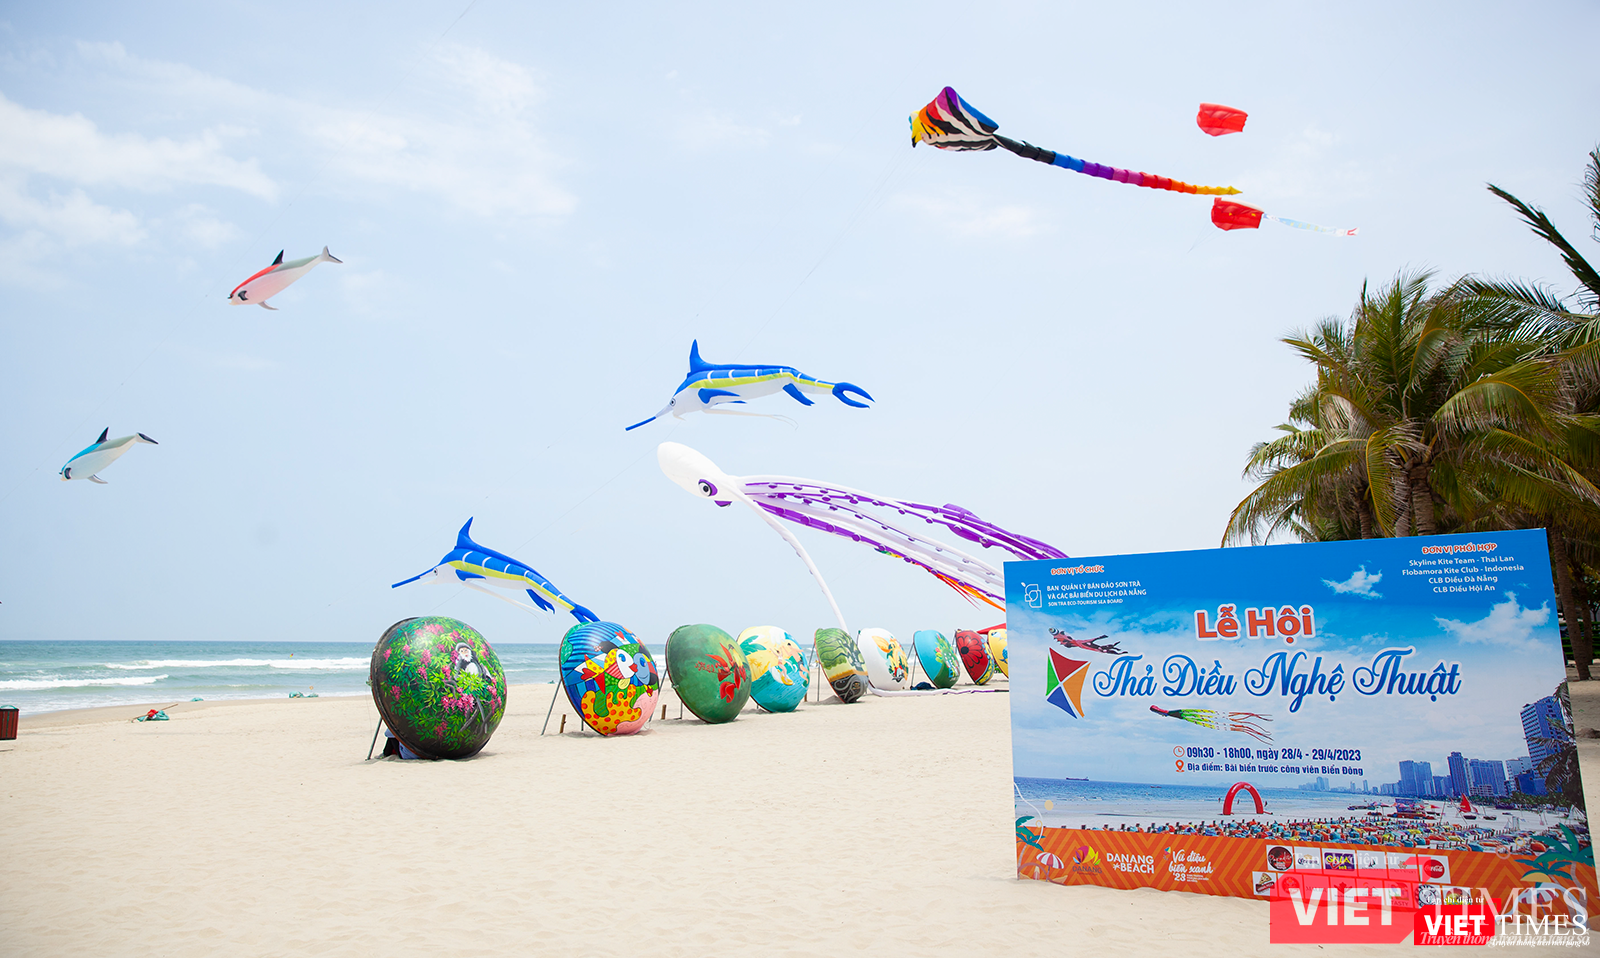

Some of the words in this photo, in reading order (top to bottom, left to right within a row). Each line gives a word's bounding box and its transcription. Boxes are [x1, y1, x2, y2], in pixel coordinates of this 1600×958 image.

[1422, 546, 1443, 554] ĐƠN
[1443, 545, 1453, 555] VỊ
[1454, 542, 1476, 553] PHỐI
[1477, 543, 1497, 553] HỢP
[1409, 558, 1437, 567] Skyline
[1051, 567, 1067, 576] ĐƠN
[1067, 566, 1075, 576] VỊ
[1075, 565, 1084, 574] TỐ
[1085, 564, 1104, 573] CHỨC
[1402, 568, 1443, 576] Flobamora
[1484, 564, 1524, 572] Indonesia
[1464, 574, 1475, 582] Đà
[1079, 582, 1087, 590] LÝ
[1115, 580, 1129, 588] SƠN
[1469, 584, 1484, 594] Hội
[1484, 584, 1496, 592] An
[1047, 592, 1057, 600] VÀ
[1105, 590, 1118, 598] LỊCH
[1119, 588, 1128, 597] ĐÀ
[1196, 603, 1240, 640] Lễ
[1248, 604, 1314, 644] Hội
[1092, 654, 1158, 697] Thả
[1162, 654, 1237, 697] Diều
[1244, 651, 1346, 713] Nghệ
[1352, 647, 1462, 702] Thuật
[1186, 746, 1215, 758] 09h30
[1222, 747, 1254, 760] 18h00,
[1256, 747, 1279, 761] ngày
[1281, 747, 1303, 760] 28/4
[1312, 748, 1362, 761] 29/4/2023
[1187, 763, 1201, 772] Địa
[1202, 762, 1223, 772] điểm:
[1225, 763, 1238, 772] Bãi
[1239, 762, 1257, 773] biển
[1258, 764, 1279, 774] trước
[1280, 764, 1301, 775] công
[1302, 765, 1320, 774] viên
[1321, 765, 1340, 775] Biển
[1341, 765, 1364, 777] Đông
[1106, 852, 1155, 865] DANANG
[1072, 865, 1103, 874] DANANG
[1120, 863, 1155, 874] BEACH
[1189, 862, 1214, 874] xanh
